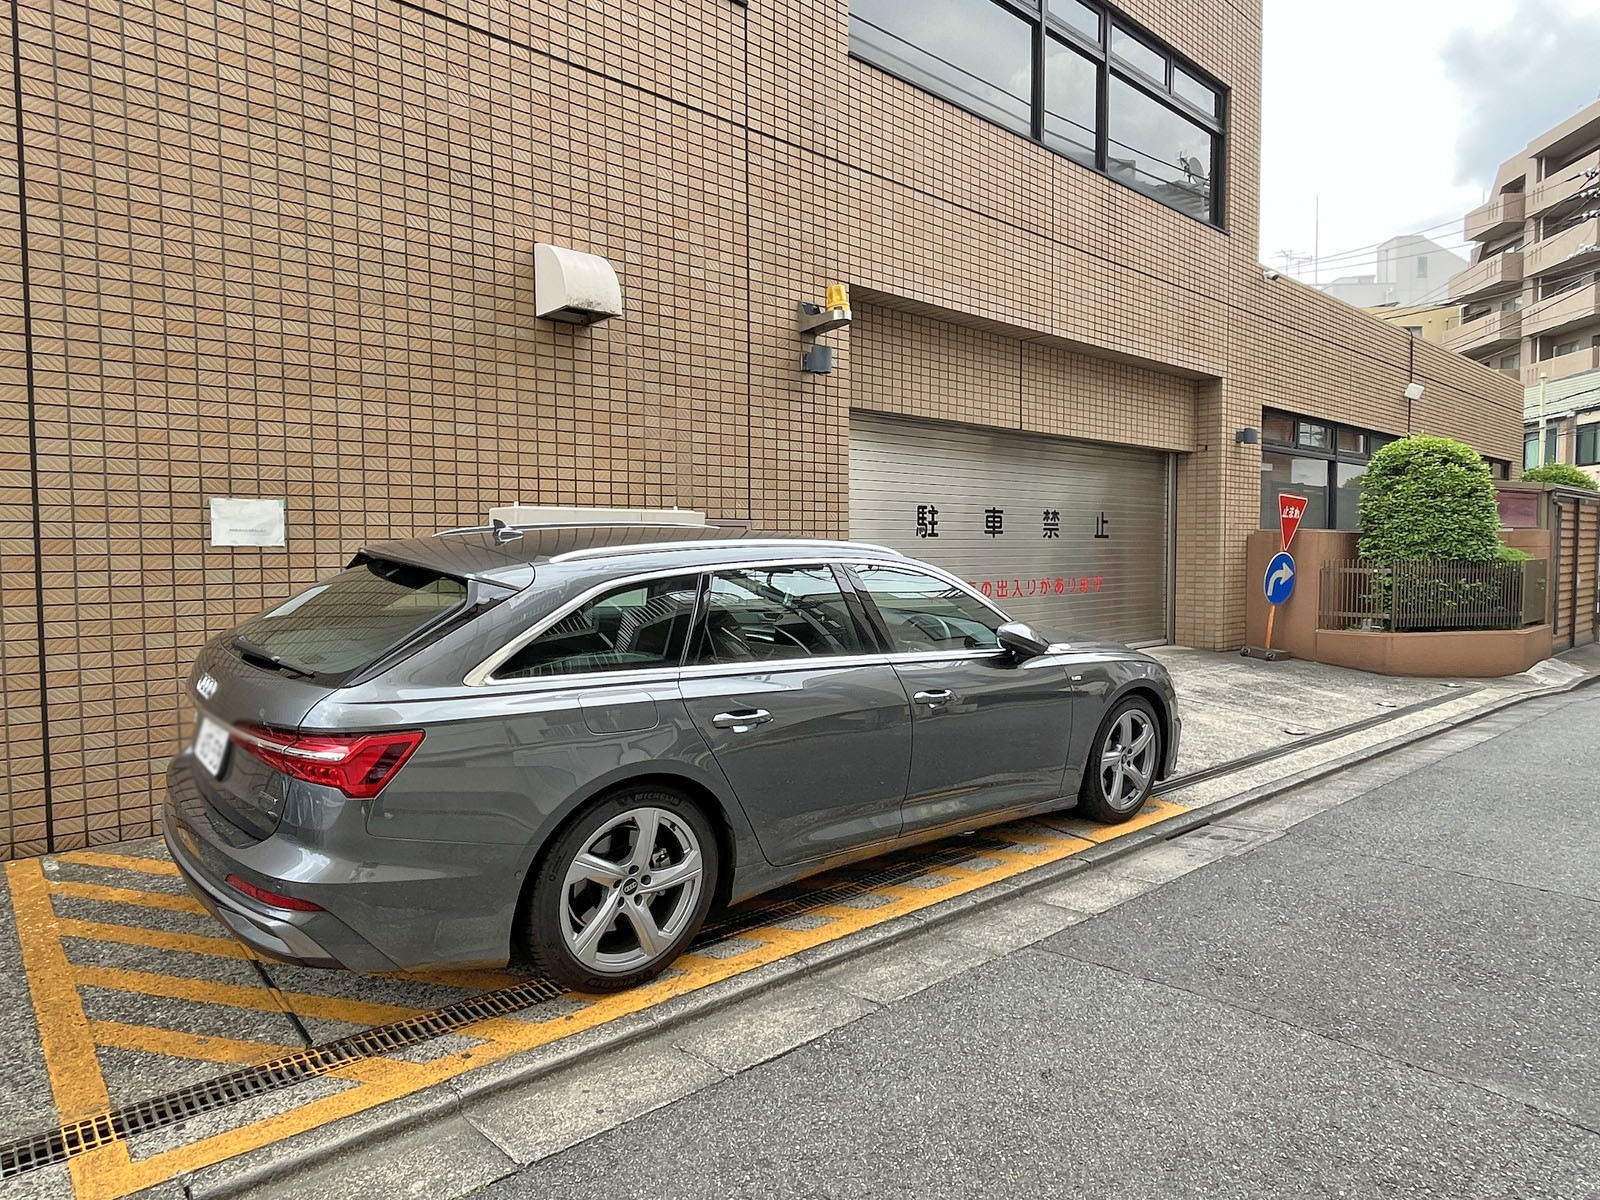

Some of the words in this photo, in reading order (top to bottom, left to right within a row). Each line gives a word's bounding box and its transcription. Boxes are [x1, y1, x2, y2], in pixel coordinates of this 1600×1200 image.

[1282, 505, 1301, 519] 止まれ
[915, 505, 1109, 539] 駐車禁止
[967, 575, 1103, 599] の出入りがあります
[634, 792, 680, 805] MICHELIN
